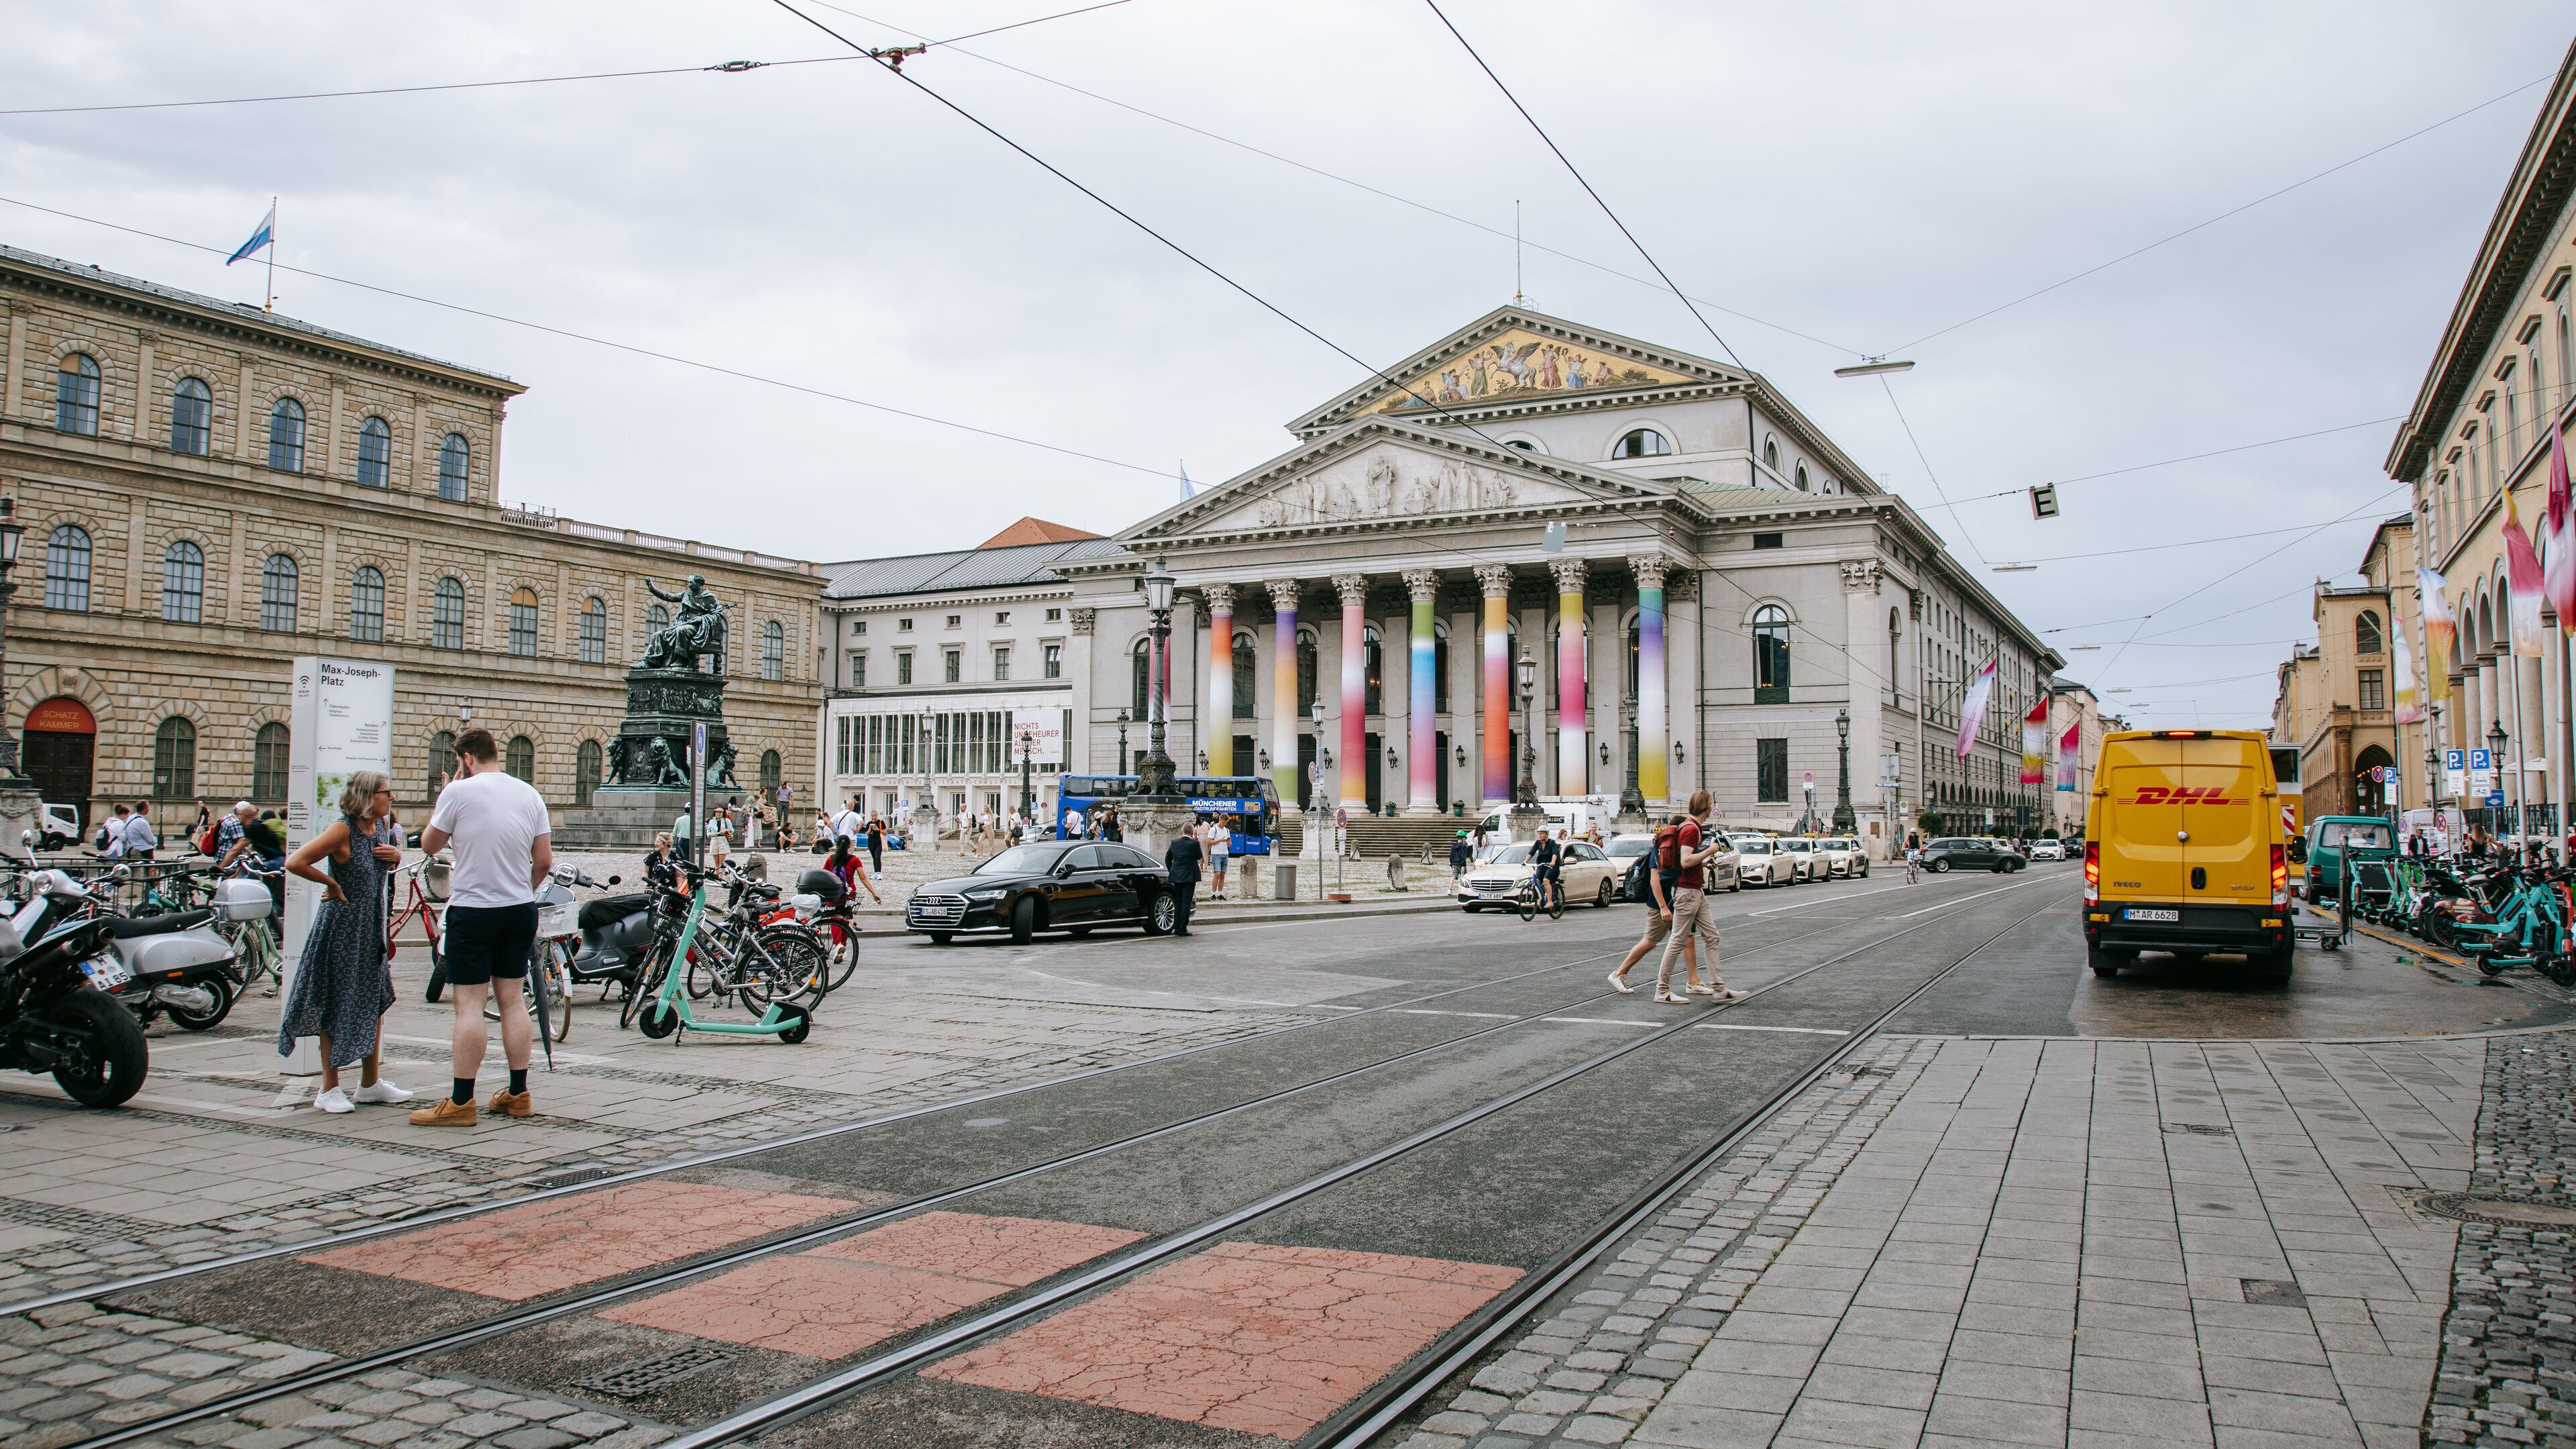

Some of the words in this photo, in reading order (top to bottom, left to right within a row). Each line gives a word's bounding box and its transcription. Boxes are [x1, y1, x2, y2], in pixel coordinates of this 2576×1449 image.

[2033, 489, 2055, 517] E
[321, 664, 380, 679] Max-Joseph-
[321, 676, 344, 686] Platz
[43, 710, 78, 719] SCHATZ
[40, 720, 79, 729] KAMMER
[1014, 747, 1044, 755] MESCH.
[2449, 753, 2459, 768] P
[2473, 751, 2484, 767] P
[2386, 769, 2393, 782] P
[2134, 787, 2233, 805] DHL
[1192, 799, 1237, 807] MÜNCHENER
[690, 909, 700, 923] Bolt
[2129, 909, 2136, 918] M
[2141, 910, 2153, 919] AR
[2155, 911, 2177, 920] 6628
[113, 971, 129, 983] 85
